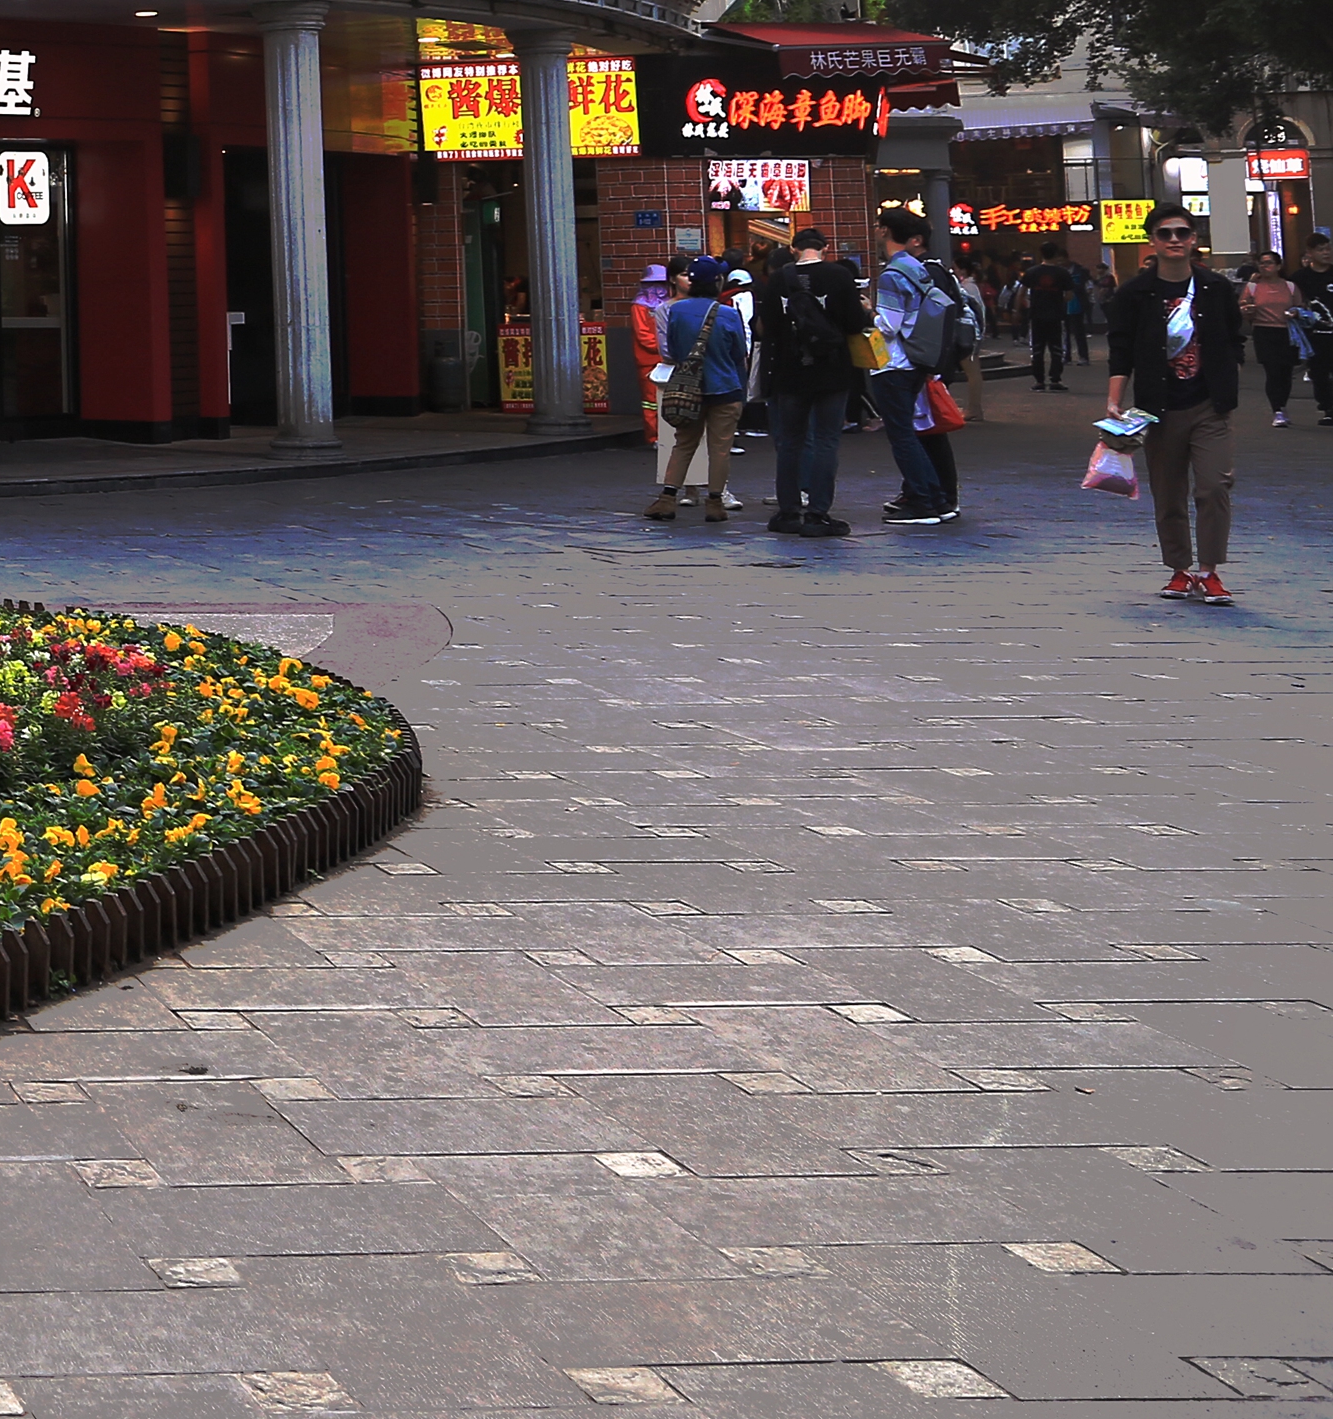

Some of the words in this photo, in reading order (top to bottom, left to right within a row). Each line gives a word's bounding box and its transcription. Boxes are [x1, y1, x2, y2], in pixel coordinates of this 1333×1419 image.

[810, 47, 927, 70] 林氏芒果巨无霸
[728, 89, 873, 131] 深海章鱼脚
[6, 159, 39, 208] K
